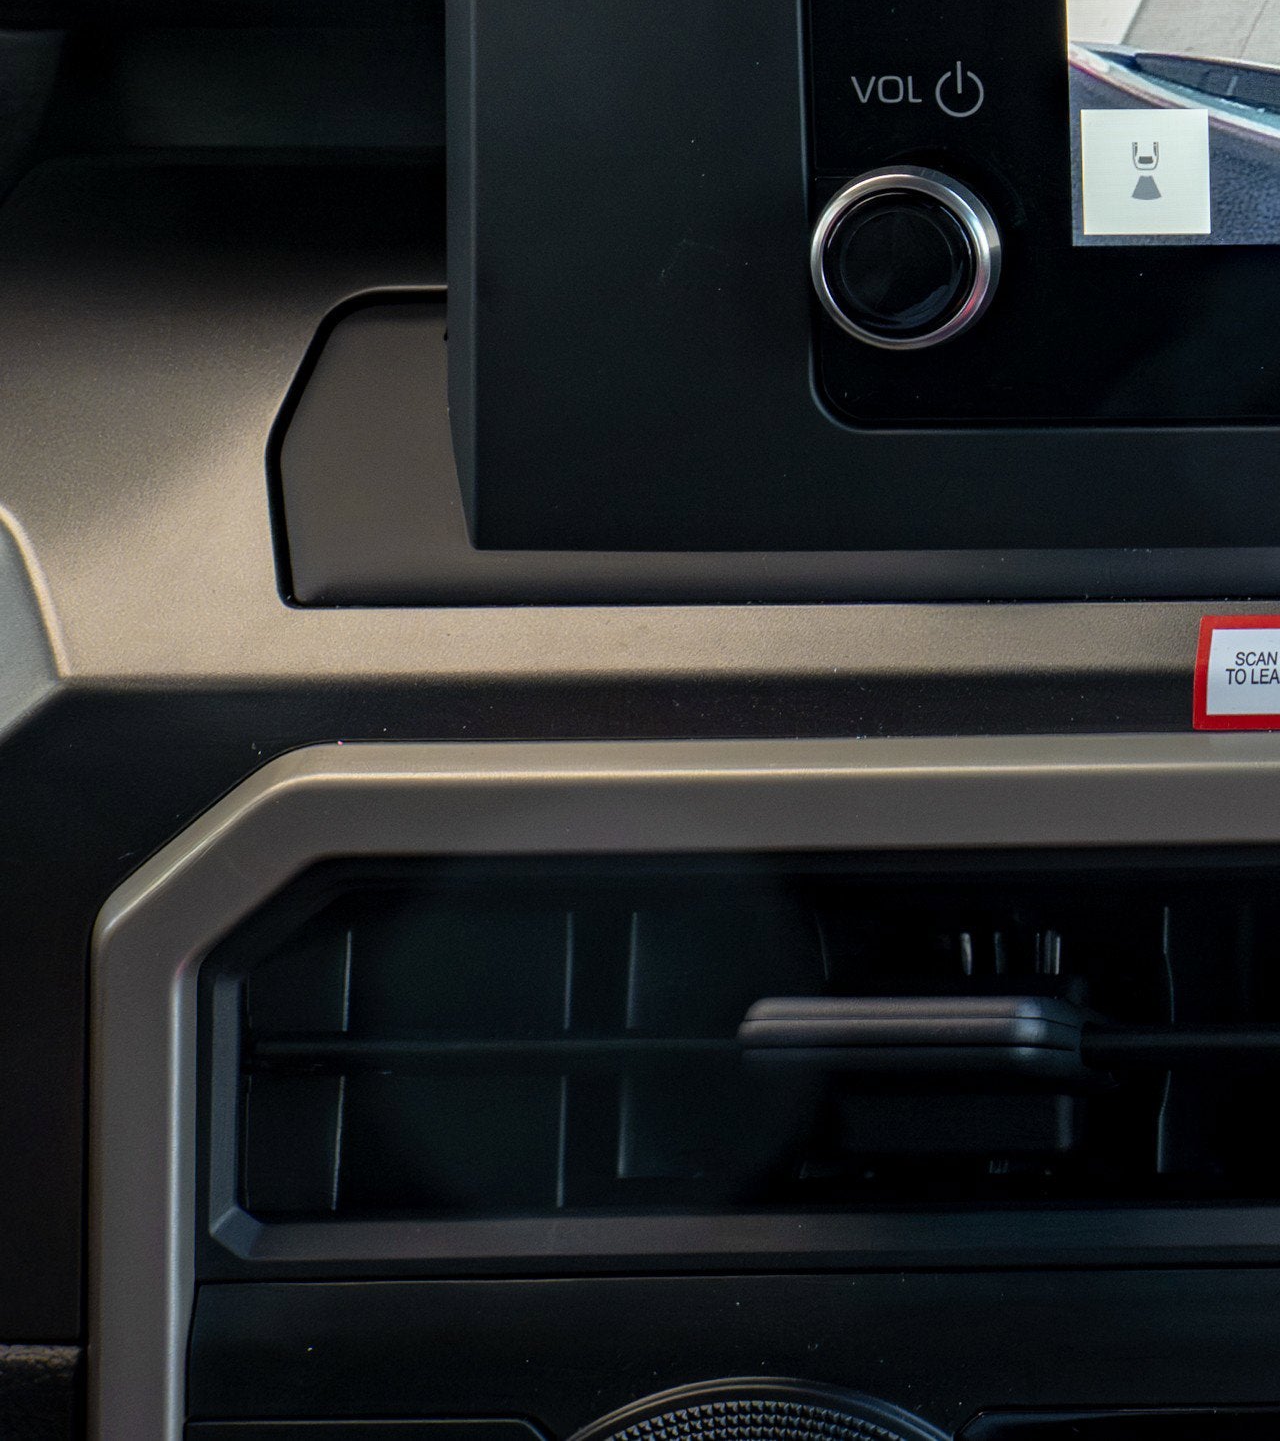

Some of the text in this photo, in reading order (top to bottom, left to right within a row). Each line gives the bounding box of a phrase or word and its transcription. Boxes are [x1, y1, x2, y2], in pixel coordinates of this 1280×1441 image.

[850, 75, 923, 104] VOL
[1234, 651, 1278, 667] SCAN
[1225, 667, 1247, 685] TO
